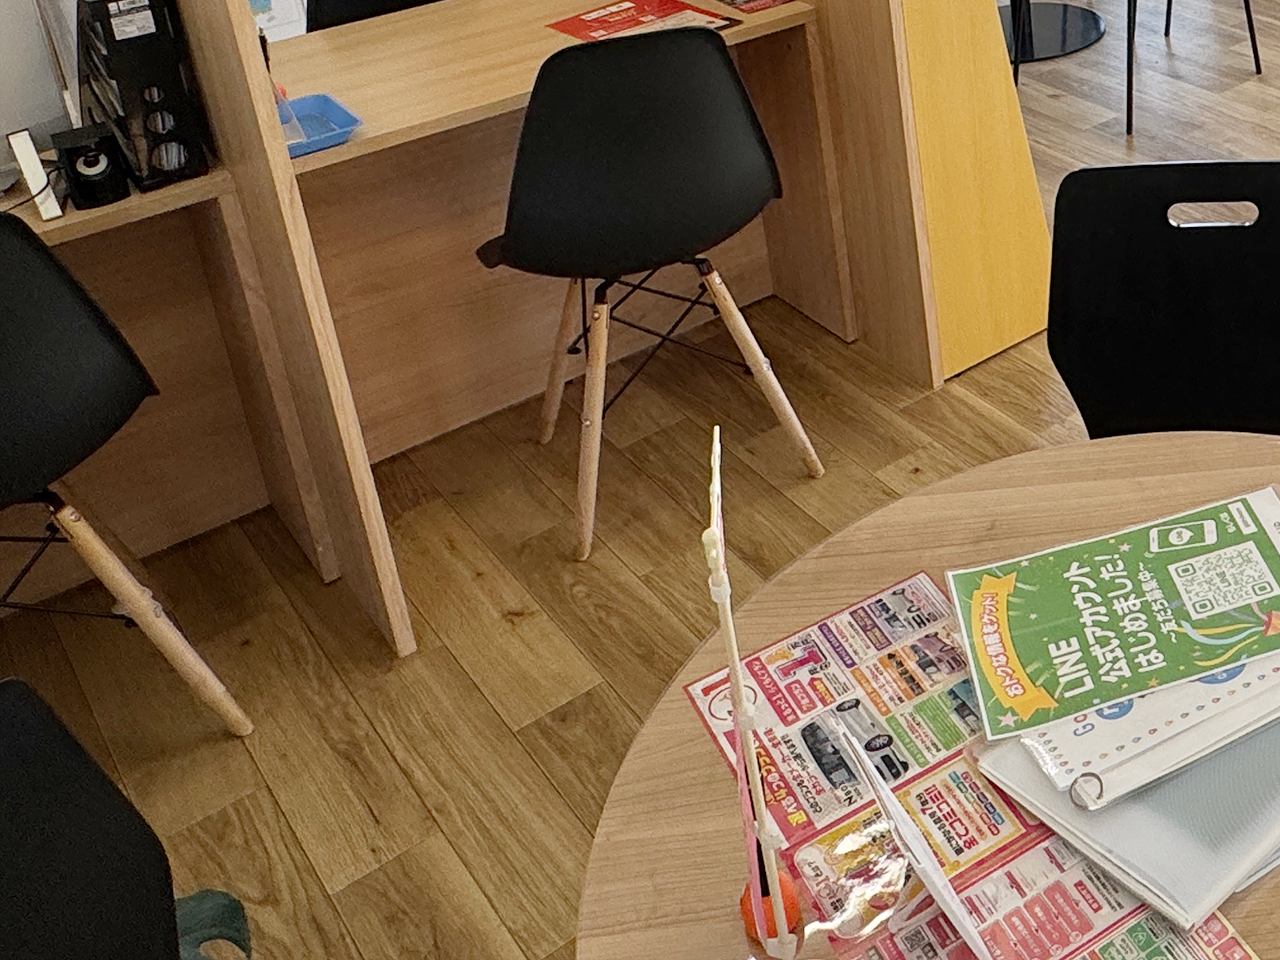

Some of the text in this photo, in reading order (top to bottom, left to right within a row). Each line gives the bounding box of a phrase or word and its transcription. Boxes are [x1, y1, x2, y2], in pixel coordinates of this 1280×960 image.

[1062, 559, 1132, 685] 公式アカウント
[1094, 552, 1166, 673] はじめました!
[1215, 570, 1231, 588] LINE
[980, 592, 1026, 699] おトクな情報をゲット!
[1046, 635, 1095, 698] LINE
[923, 783, 978, 849] 全てコミコミ!!
